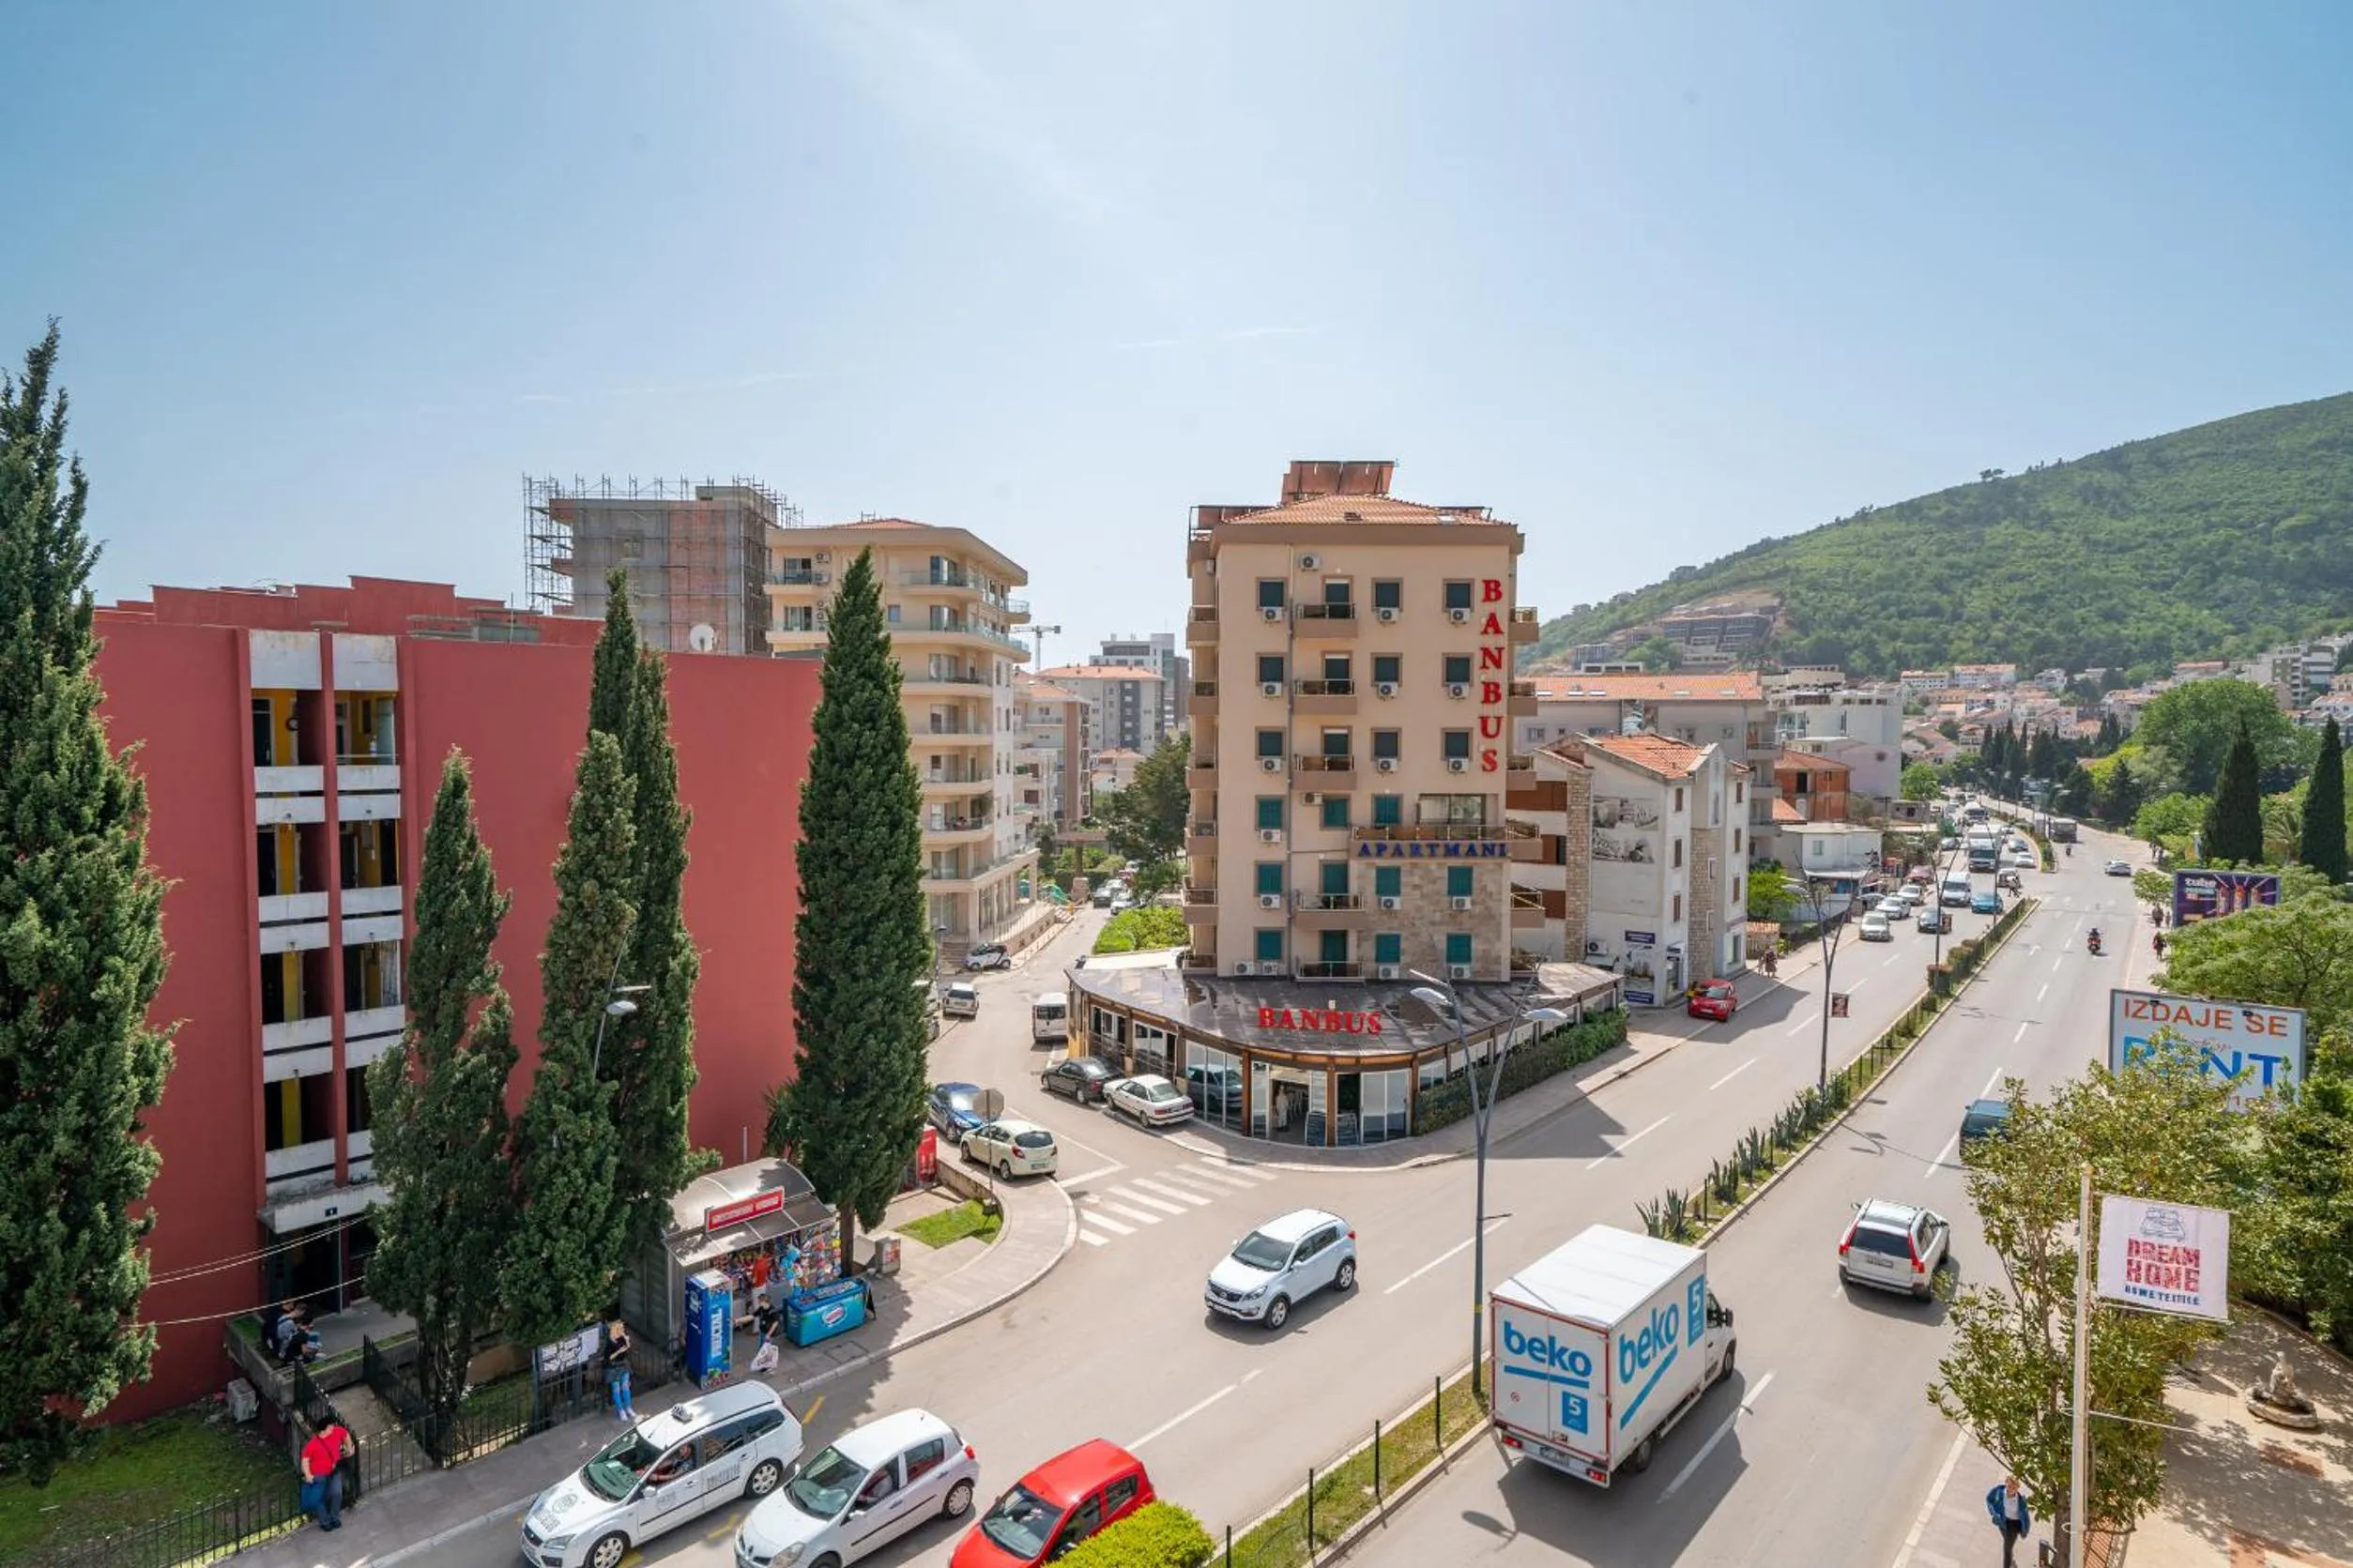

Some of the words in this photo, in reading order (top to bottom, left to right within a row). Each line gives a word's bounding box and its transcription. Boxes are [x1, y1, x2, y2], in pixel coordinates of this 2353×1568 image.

[1479, 579, 1505, 773] BANBUS
[1358, 842, 1508, 858] APARTMANI
[1257, 1005, 1383, 1036] BANBUS
[2124, 997, 2234, 1030] IZDAJE
[2244, 1012, 2288, 1037] SE
[2127, 1238, 2201, 1269] DREAM
[2126, 1258, 2200, 1293] HOME
[1692, 1283, 1702, 1316] 5
[1504, 1320, 1593, 1378] beko
[1618, 1302, 1680, 1384] beko
[1568, 1395, 1581, 1416] 5
